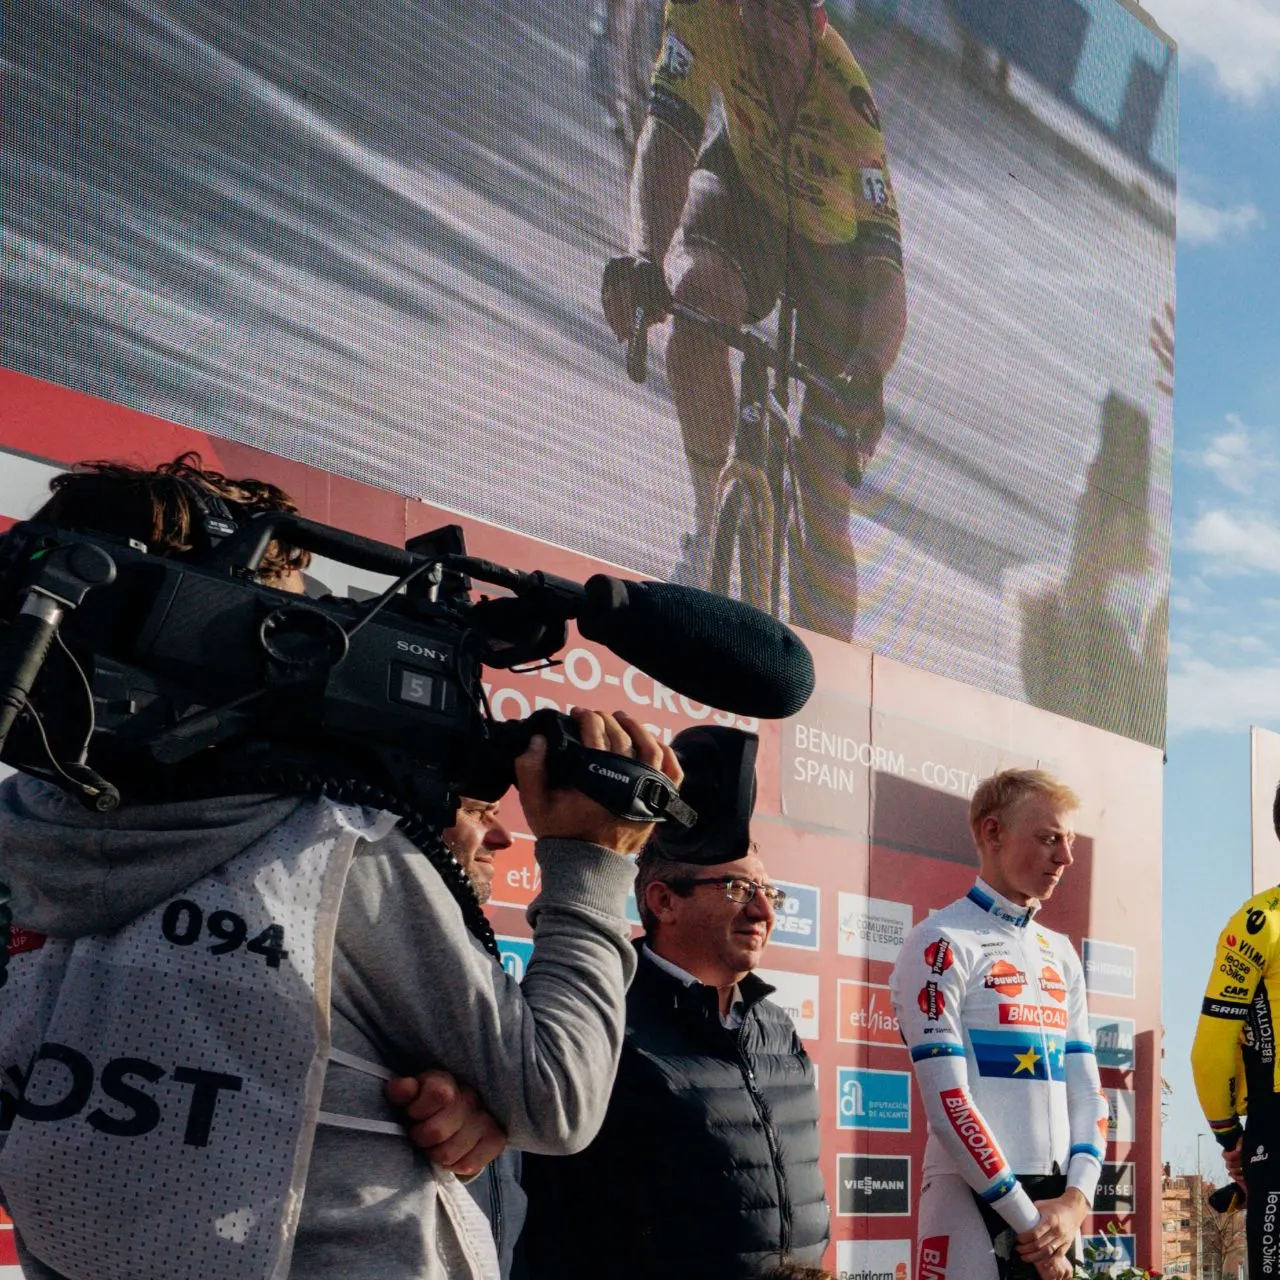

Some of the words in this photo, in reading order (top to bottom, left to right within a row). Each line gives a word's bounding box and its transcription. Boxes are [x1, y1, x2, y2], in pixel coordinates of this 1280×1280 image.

[396, 640, 449, 663] SONY
[409, 677, 425, 698] 5
[794, 724, 904, 776] BENIDORM
[588, 762, 630, 785] Canon
[793, 757, 854, 794] SPAIN
[162, 899, 288, 968] 094
[933, 939, 949, 975] Pauwels
[1085, 959, 1132, 979] SHIMANO
[1224, 952, 1251, 974] lease
[987, 973, 1026, 986] Pauwels
[849, 994, 899, 1035] ethias
[928, 983, 937, 1020] Pauwels
[1210, 1004, 1249, 1015] SRAM
[0, 1041, 243, 1148] OST
